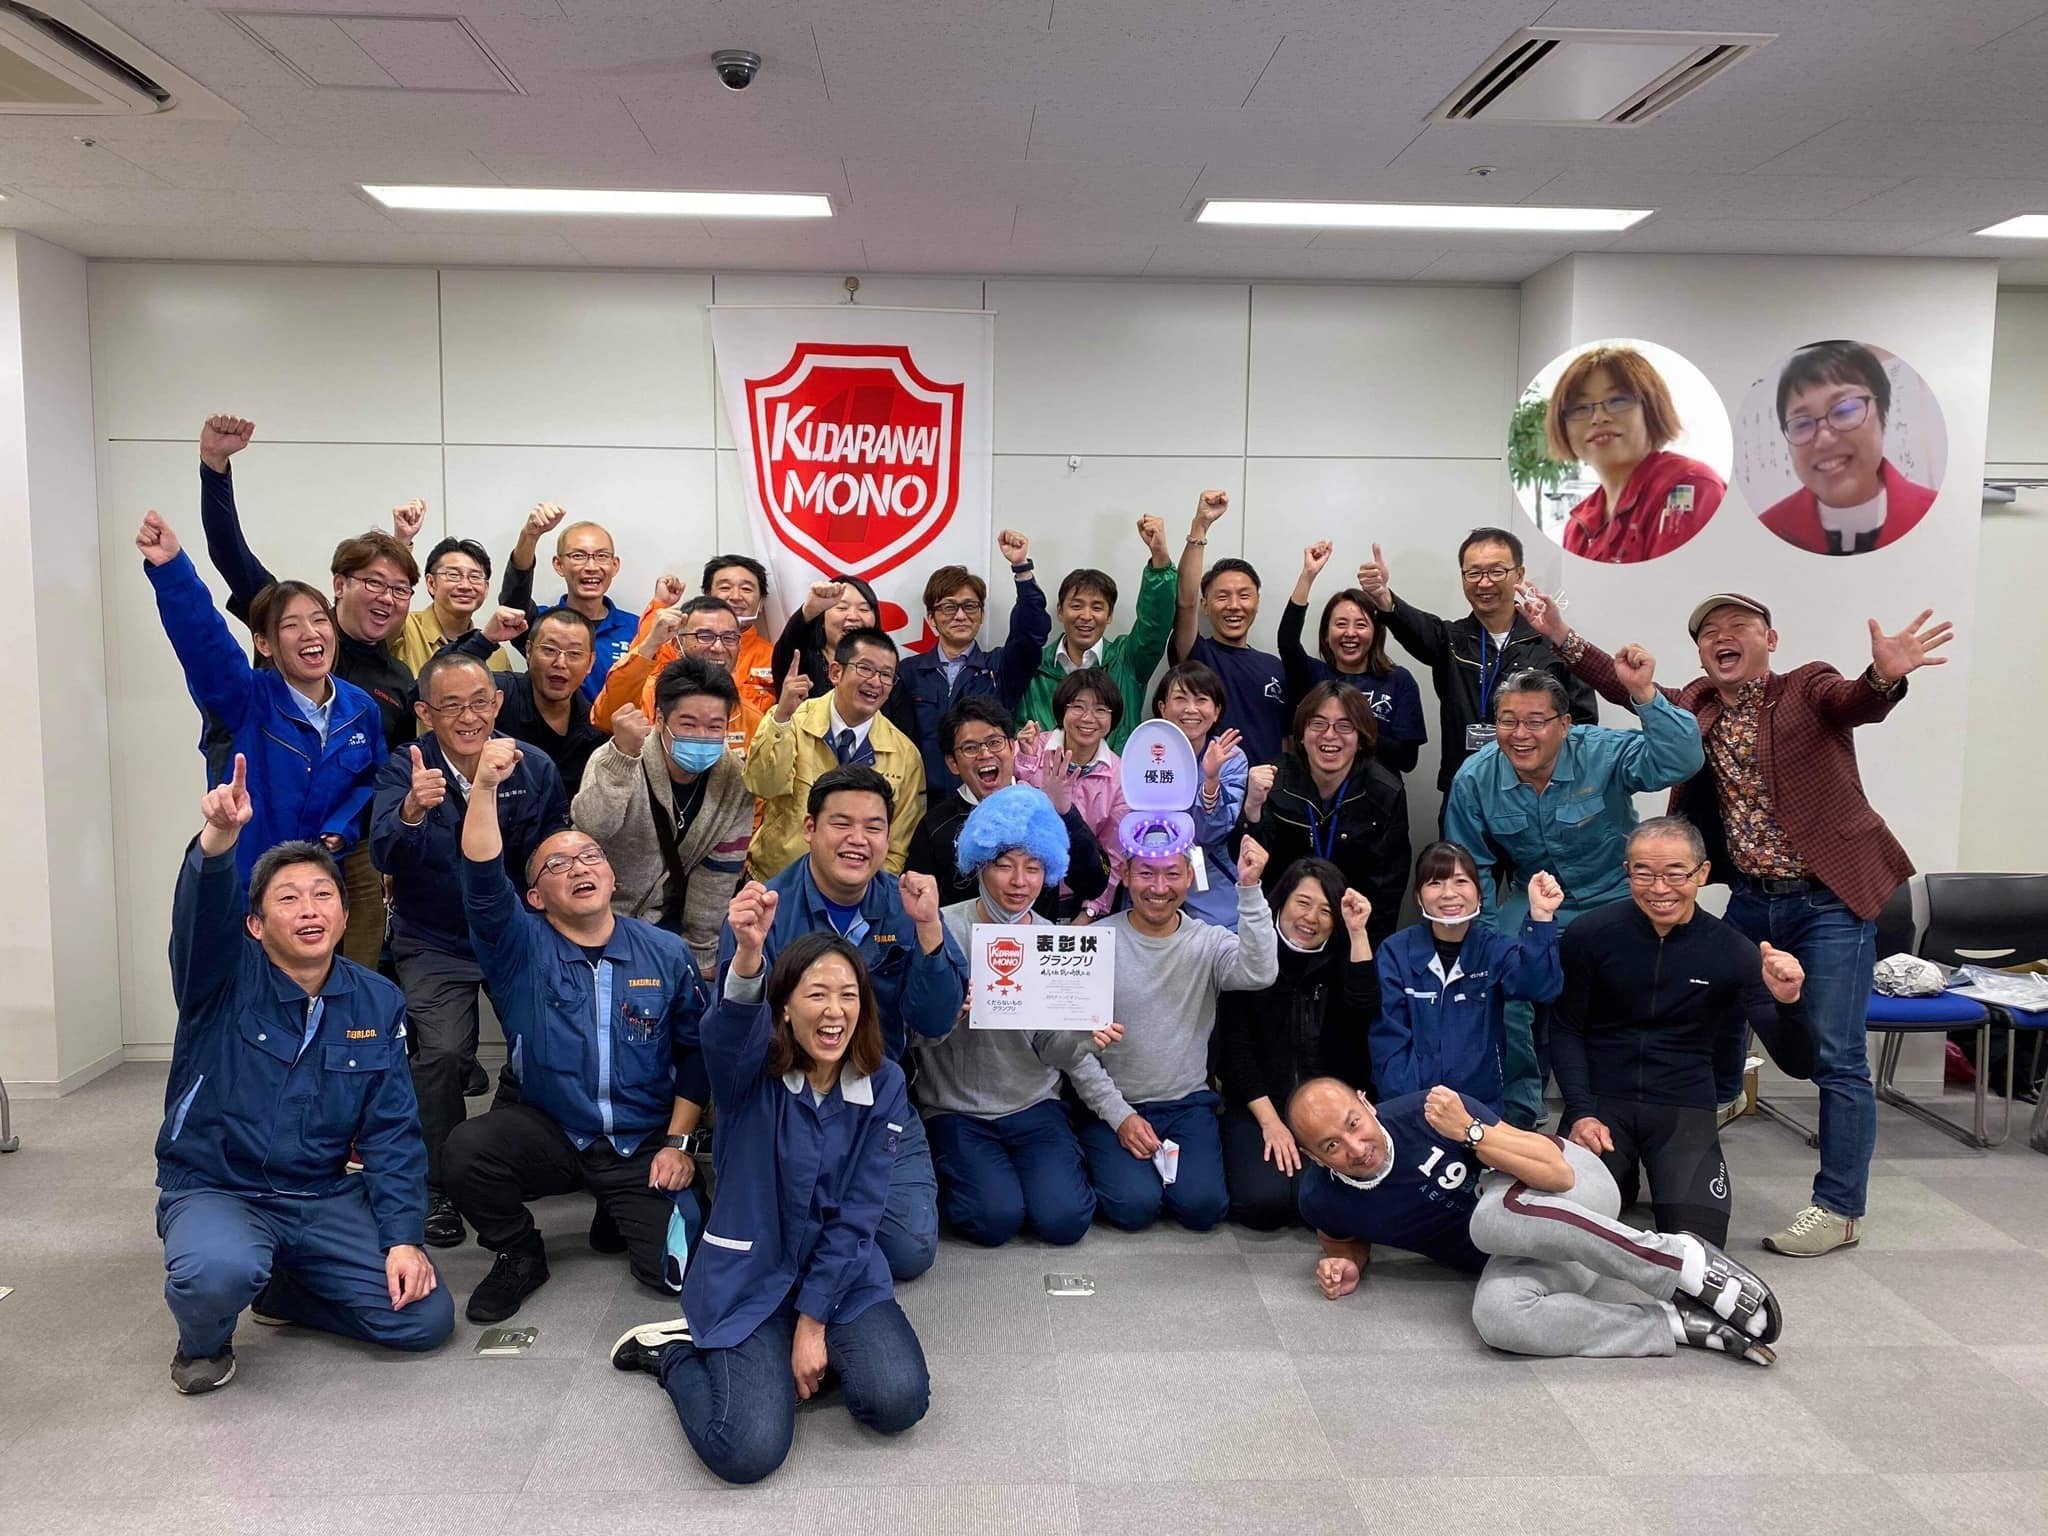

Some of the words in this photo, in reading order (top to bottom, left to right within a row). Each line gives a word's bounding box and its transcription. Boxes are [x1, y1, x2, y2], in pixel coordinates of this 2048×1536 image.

[771, 402, 939, 466] KUDARANAI
[783, 470, 928, 517] MONO
[1144, 769, 1174, 784] 優勝
[1037, 935, 1097, 952] 表彰状
[1040, 955, 1093, 967] グランプリ
